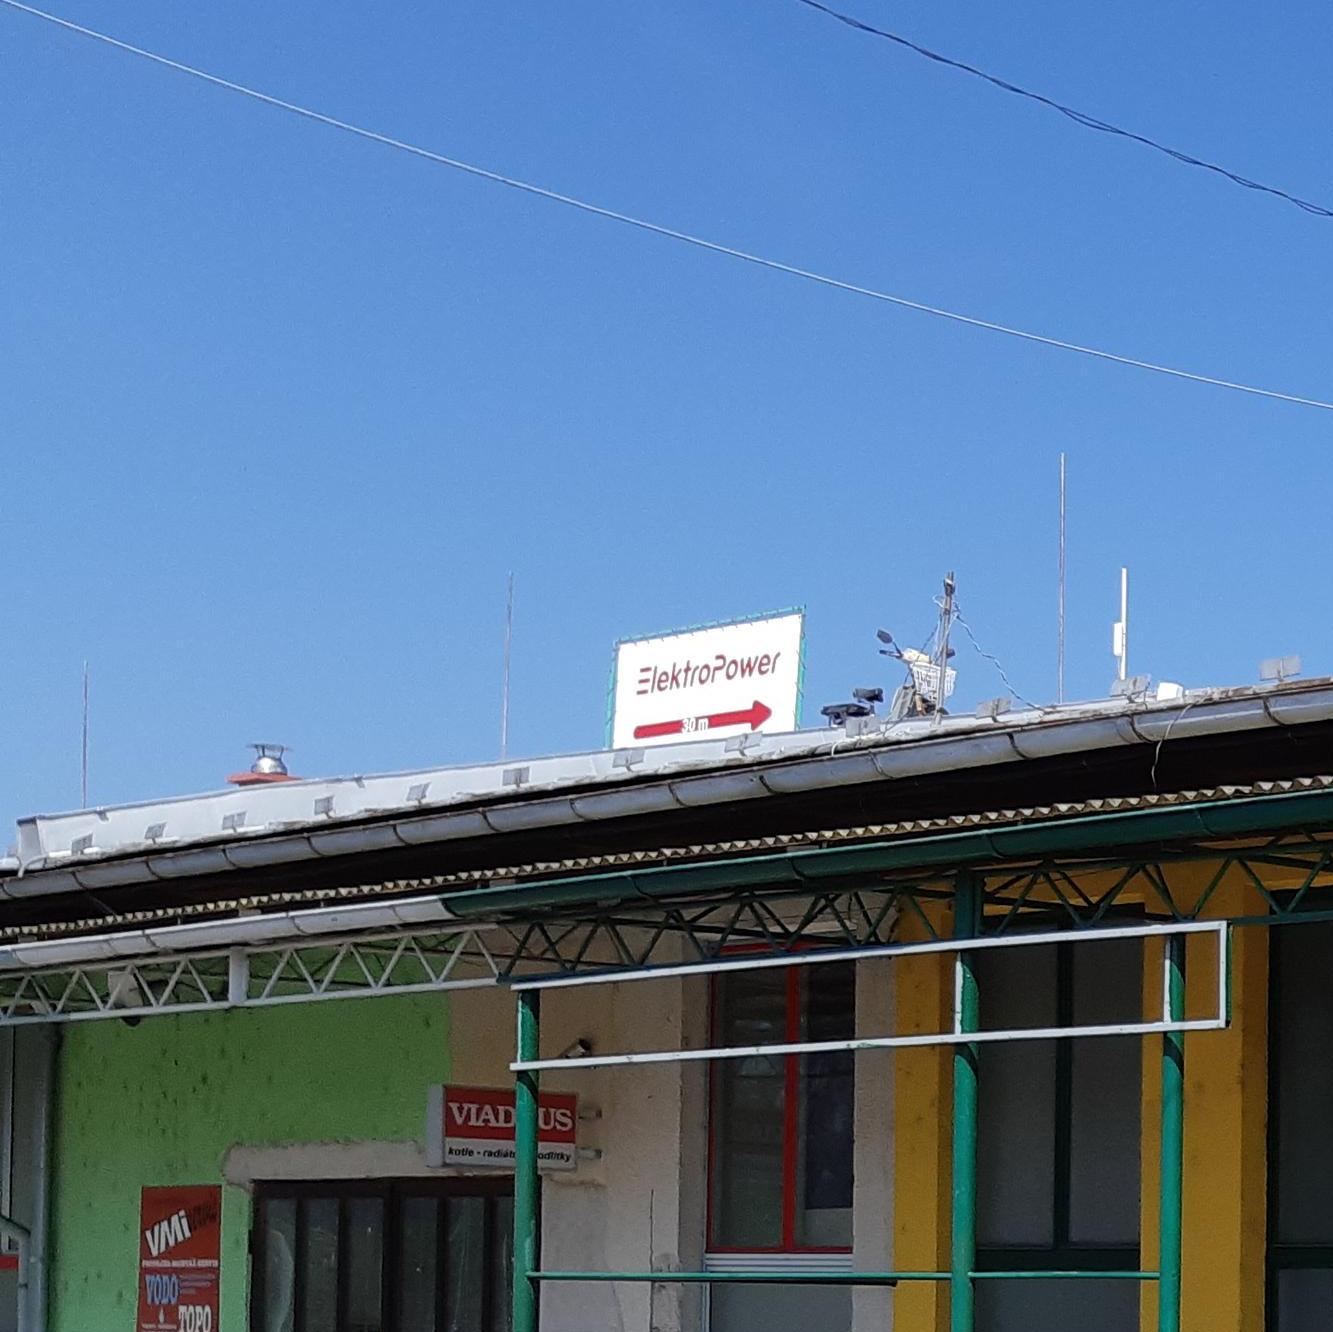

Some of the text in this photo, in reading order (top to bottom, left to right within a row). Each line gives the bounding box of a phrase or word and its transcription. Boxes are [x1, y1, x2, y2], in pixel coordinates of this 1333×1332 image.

[636, 651, 781, 695] ElektroPower
[448, 1102, 574, 1131] VIADUS
[145, 1274, 179, 1306] VODO
